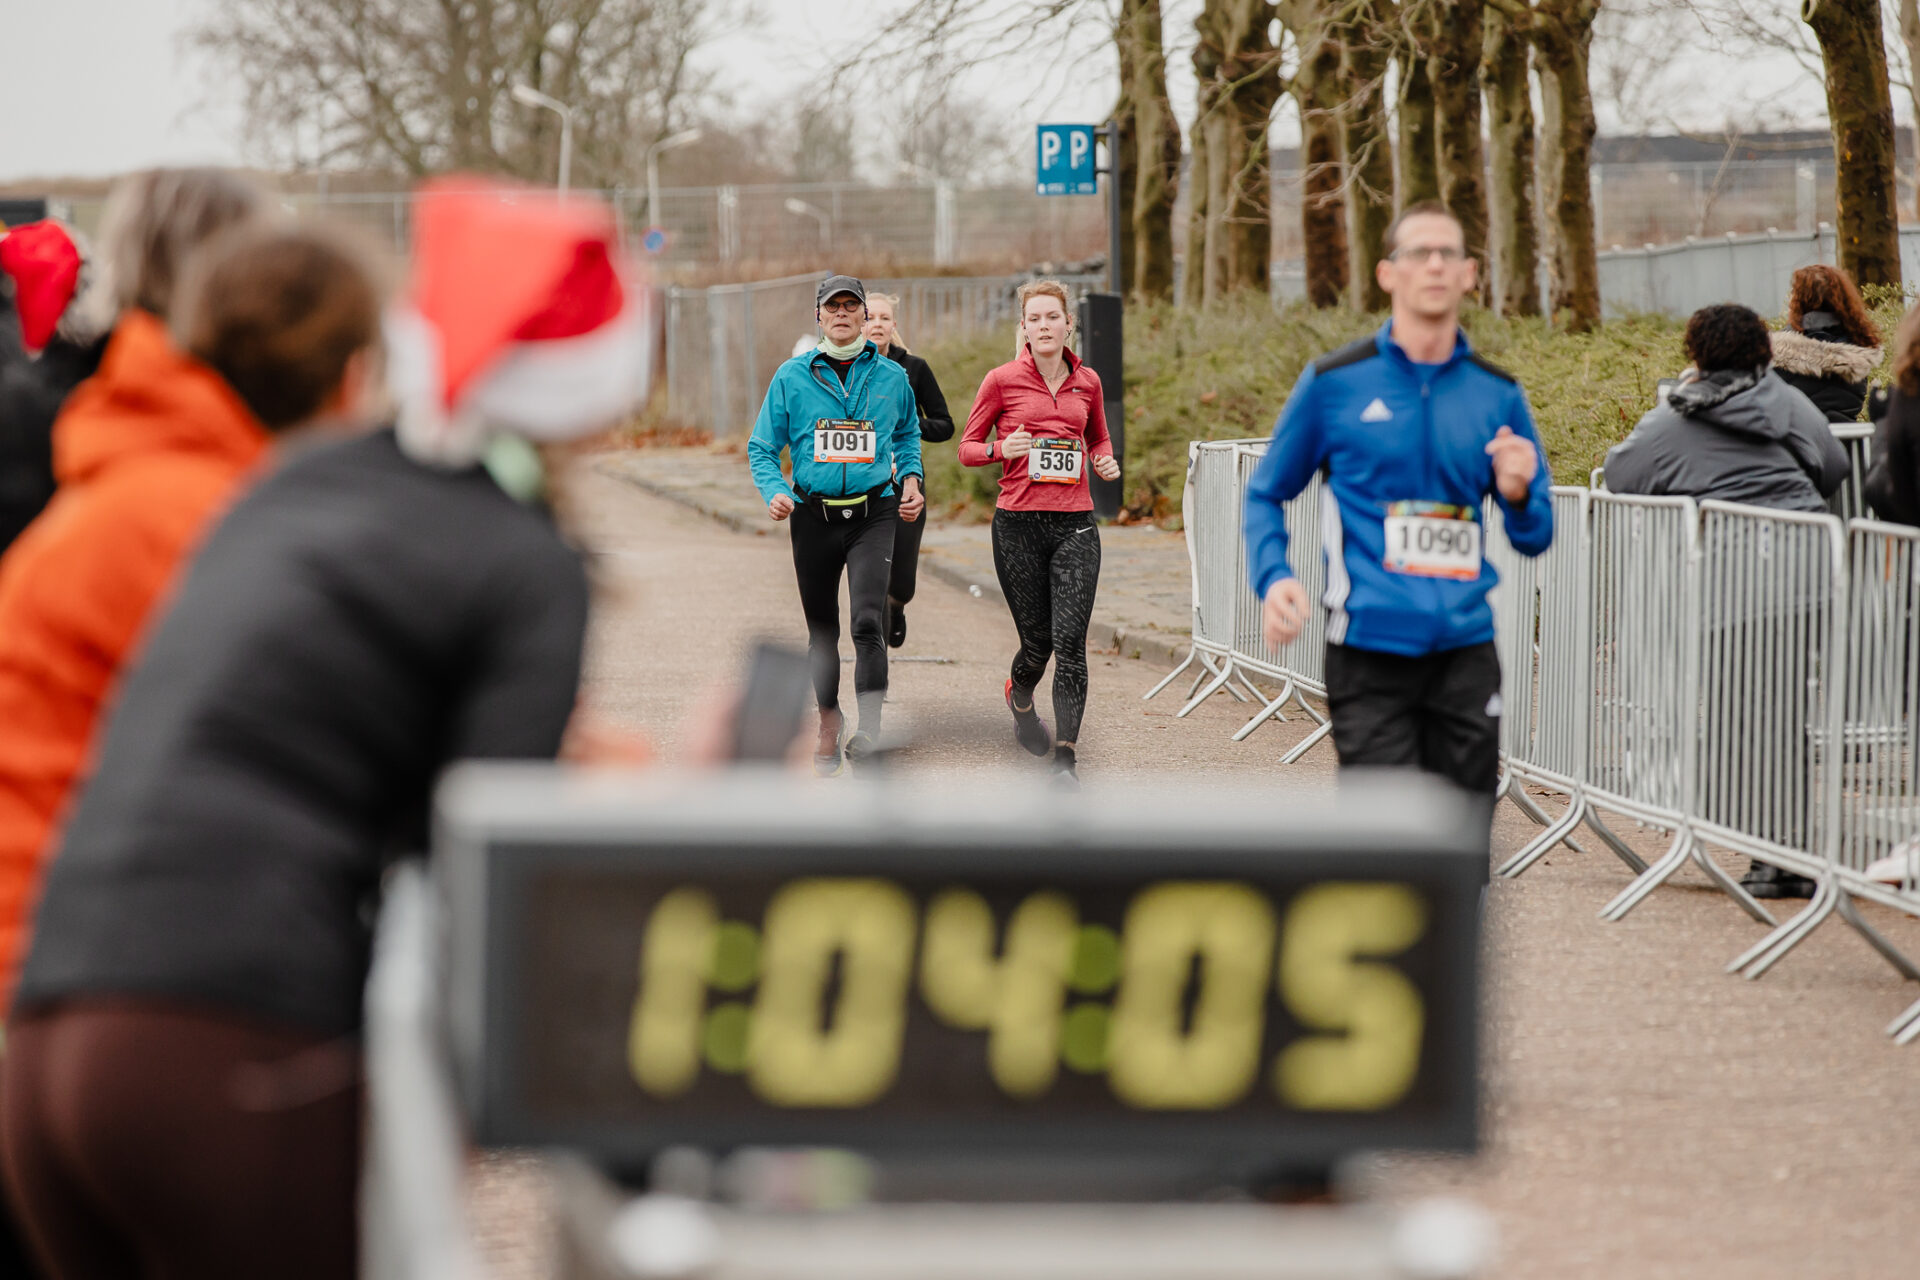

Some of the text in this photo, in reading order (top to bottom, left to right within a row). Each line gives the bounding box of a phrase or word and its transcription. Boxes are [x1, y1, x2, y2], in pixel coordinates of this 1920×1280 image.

[1041, 130, 1089, 171] P P
[820, 431, 868, 452] 1091
[1040, 451, 1075, 472] 536
[1401, 525, 1472, 556] 1090
[626, 877, 1430, 1110] 1:04:05
